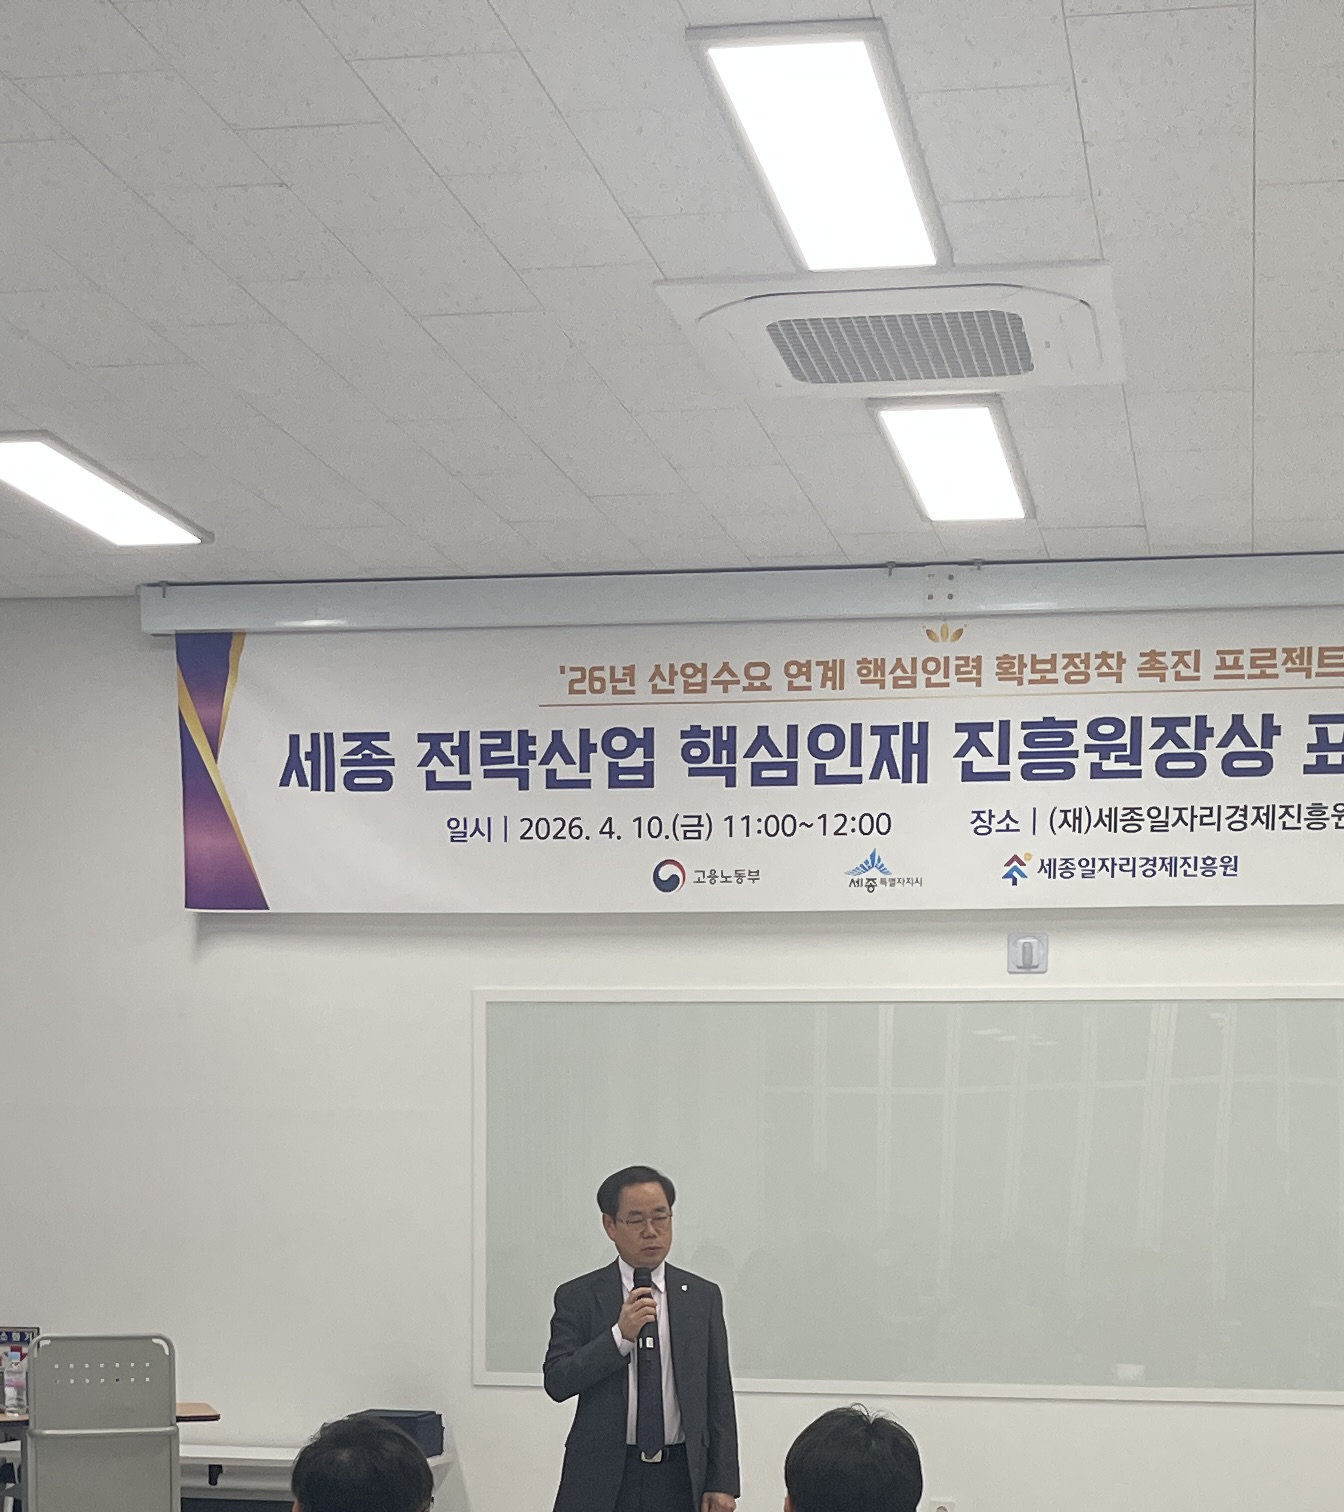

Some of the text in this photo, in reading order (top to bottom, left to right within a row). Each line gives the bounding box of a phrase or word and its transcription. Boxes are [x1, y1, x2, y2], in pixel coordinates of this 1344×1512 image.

[560, 665, 635, 695] '26년
[648, 662, 772, 694] 산업수요
[784, 659, 844, 691] 연계
[857, 656, 982, 689] 핵심인력
[996, 651, 1126, 686] 확보정착
[1137, 649, 1200, 682] 촉진
[279, 732, 395, 792] 세종
[417, 727, 654, 791] 전략산업
[680, 722, 928, 788] 핵심인재
[953, 714, 1281, 782] 진흥원장상
[447, 817, 491, 842] 일시
[520, 817, 589, 840] 2026.
[599, 817, 620, 839] 4.
[633, 813, 712, 841] 10.(금)
[724, 813, 891, 837] 11:00~12:00
[971, 809, 1020, 835] 장소
[694, 869, 760, 885] 고용노동부
[1038, 856, 1237, 879] 세종일자리경제진흥원
[849, 877, 878, 894] 세종
